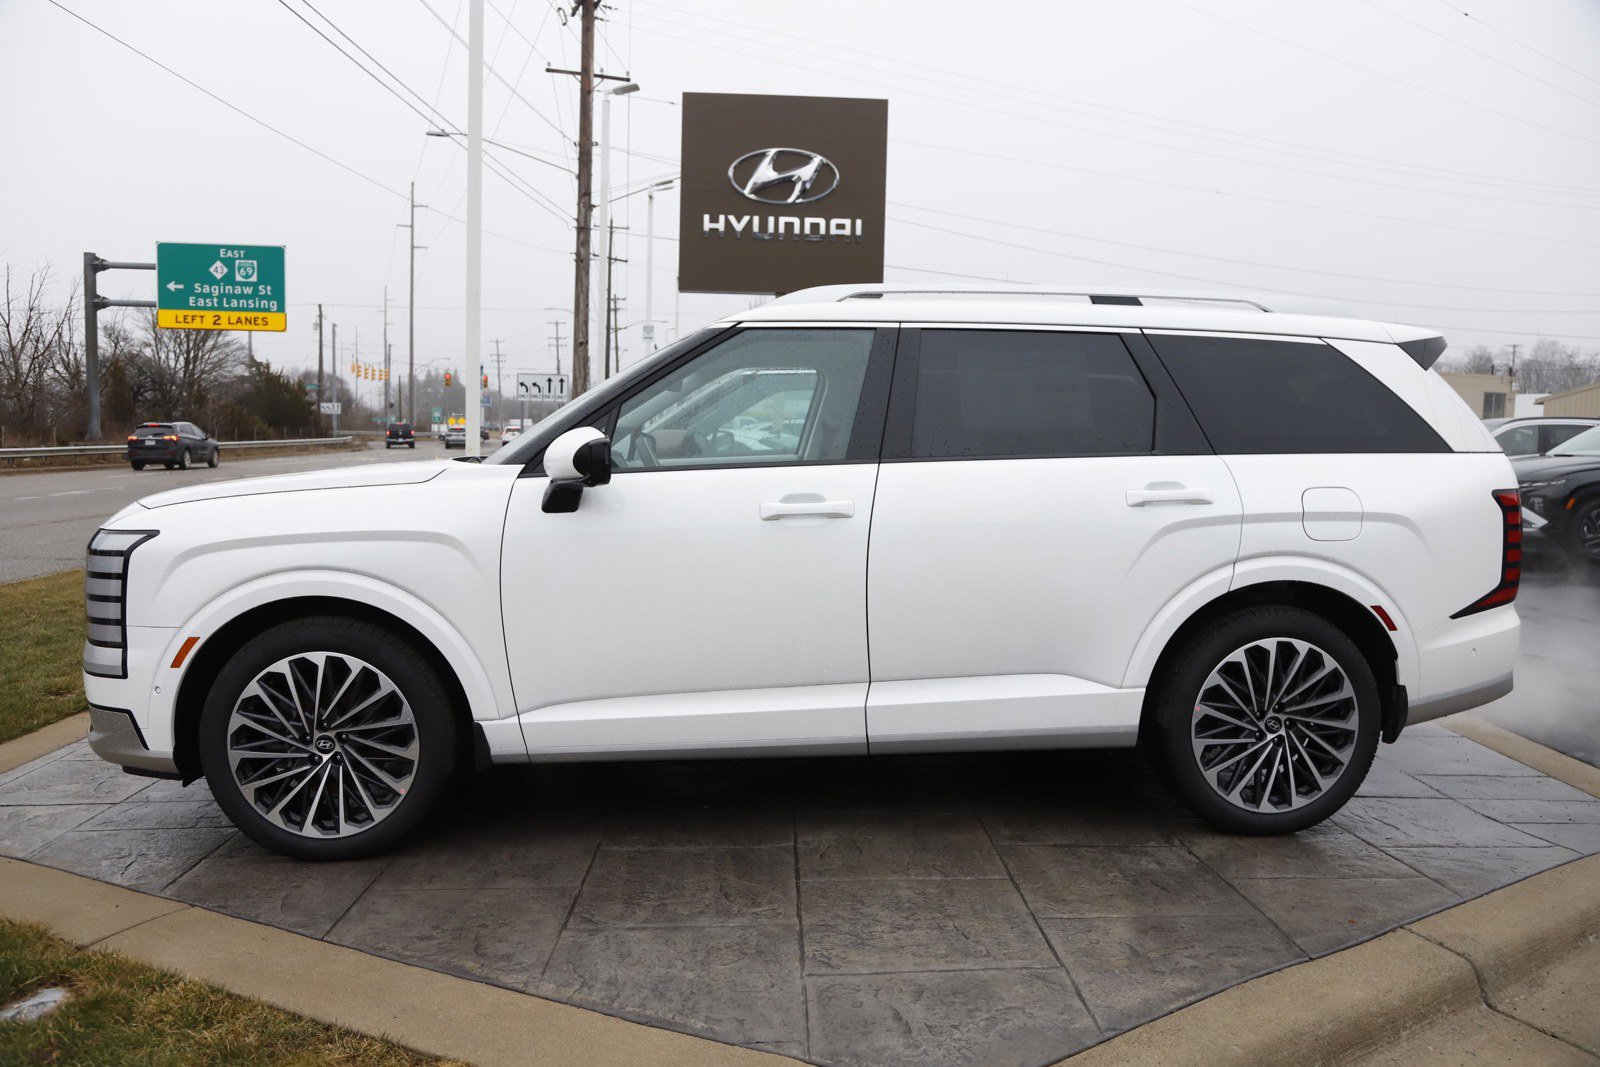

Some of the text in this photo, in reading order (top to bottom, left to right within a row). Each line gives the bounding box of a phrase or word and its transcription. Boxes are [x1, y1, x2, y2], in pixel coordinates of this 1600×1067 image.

[702, 213, 863, 240] HYUNDAI
[219, 248, 245, 258] EAST
[212, 264, 225, 275] 43
[239, 267, 253, 277] 69
[194, 282, 272, 296] Saginaw St
[189, 296, 278, 311] East Lansing
[175, 314, 269, 326] LEFT 2 LANES
